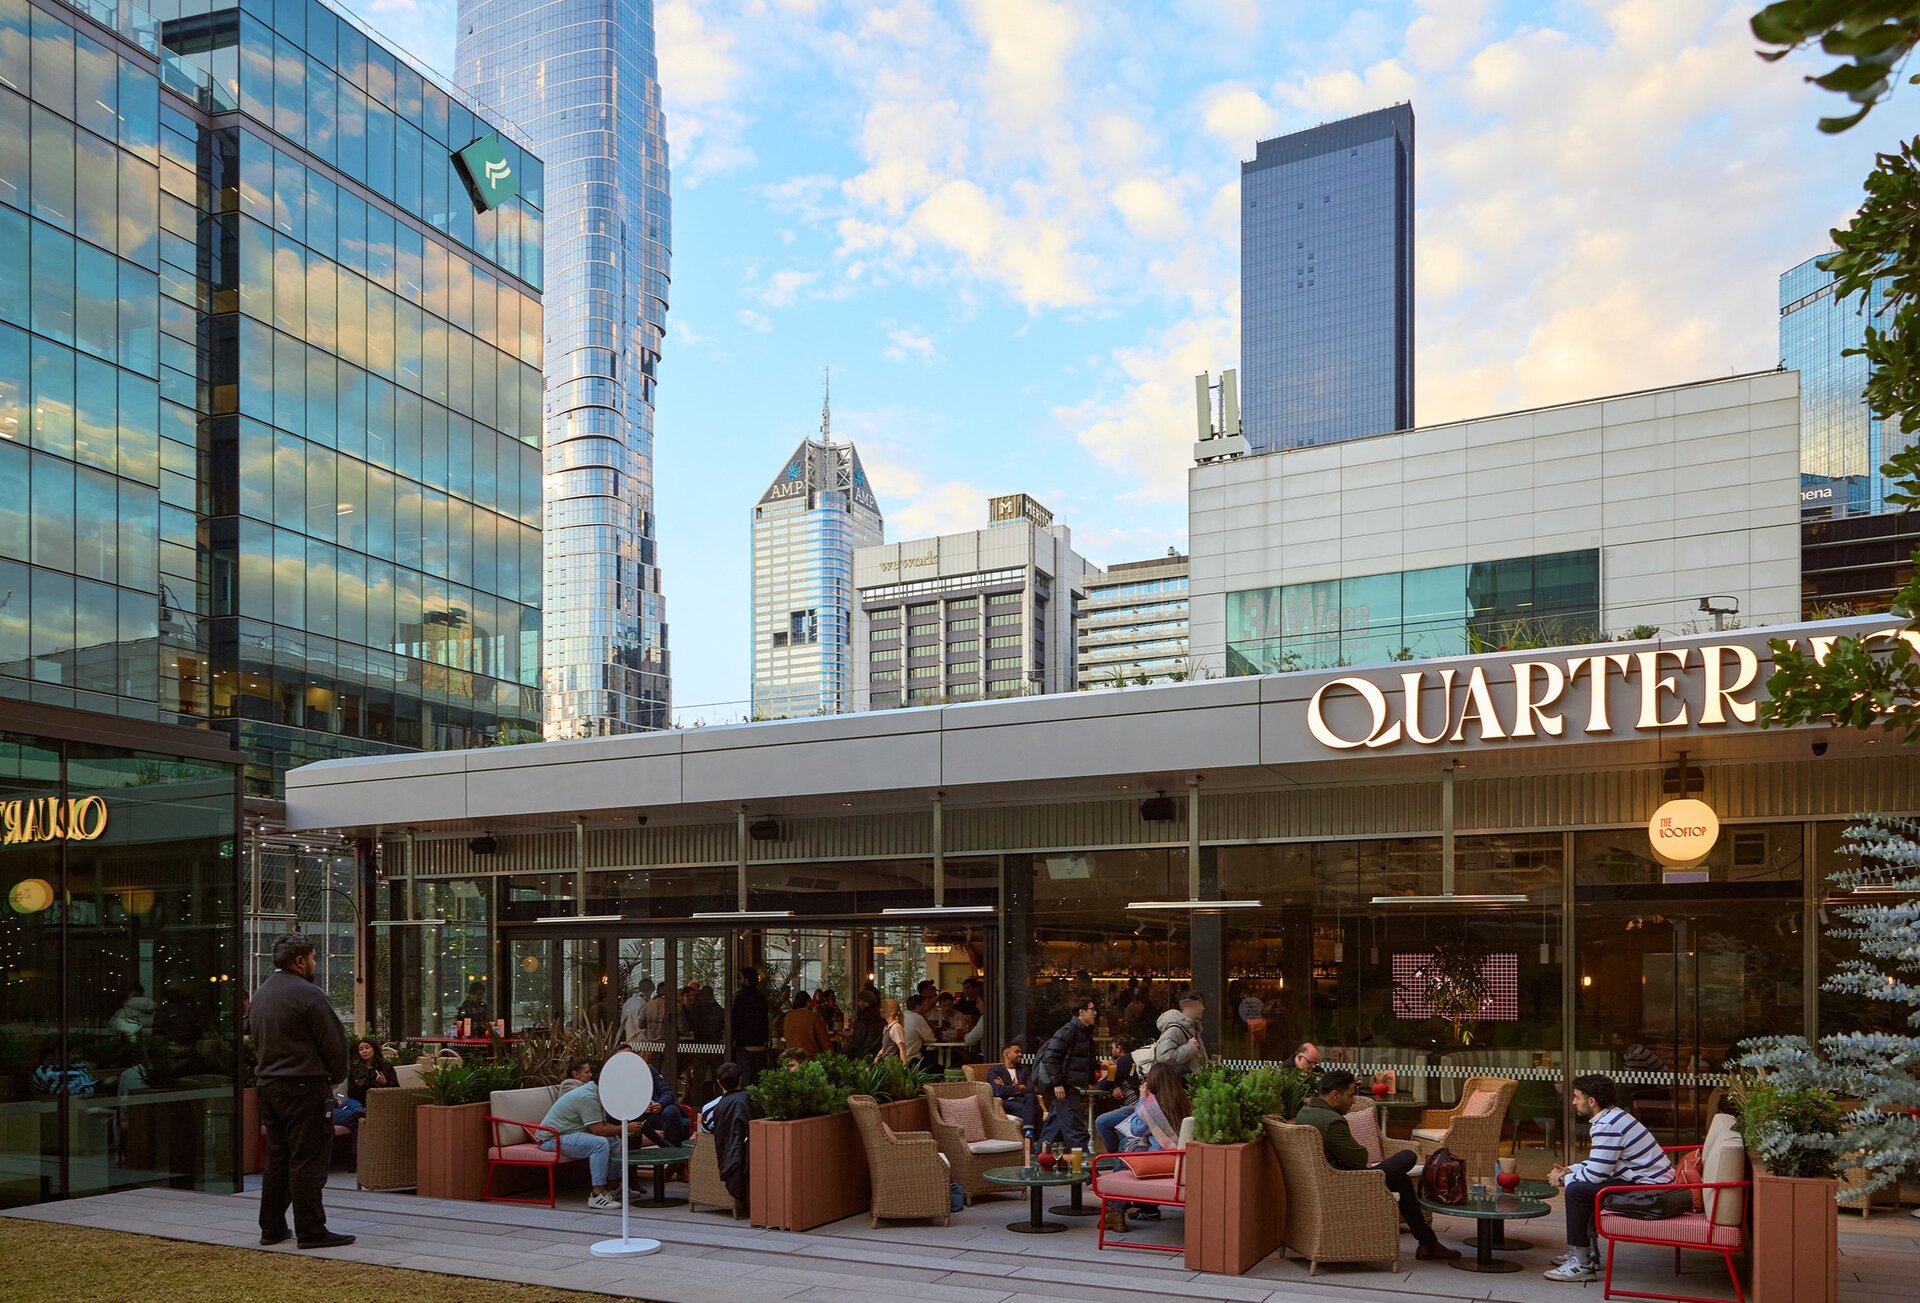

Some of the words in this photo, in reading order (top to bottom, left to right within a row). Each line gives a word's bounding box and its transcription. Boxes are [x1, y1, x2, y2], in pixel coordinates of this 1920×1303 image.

[770, 481, 804, 499] AMP
[855, 487, 876, 508] AMP
[1660, 817, 1672, 828] THE
[1659, 826, 1707, 838] ROOFTOP
